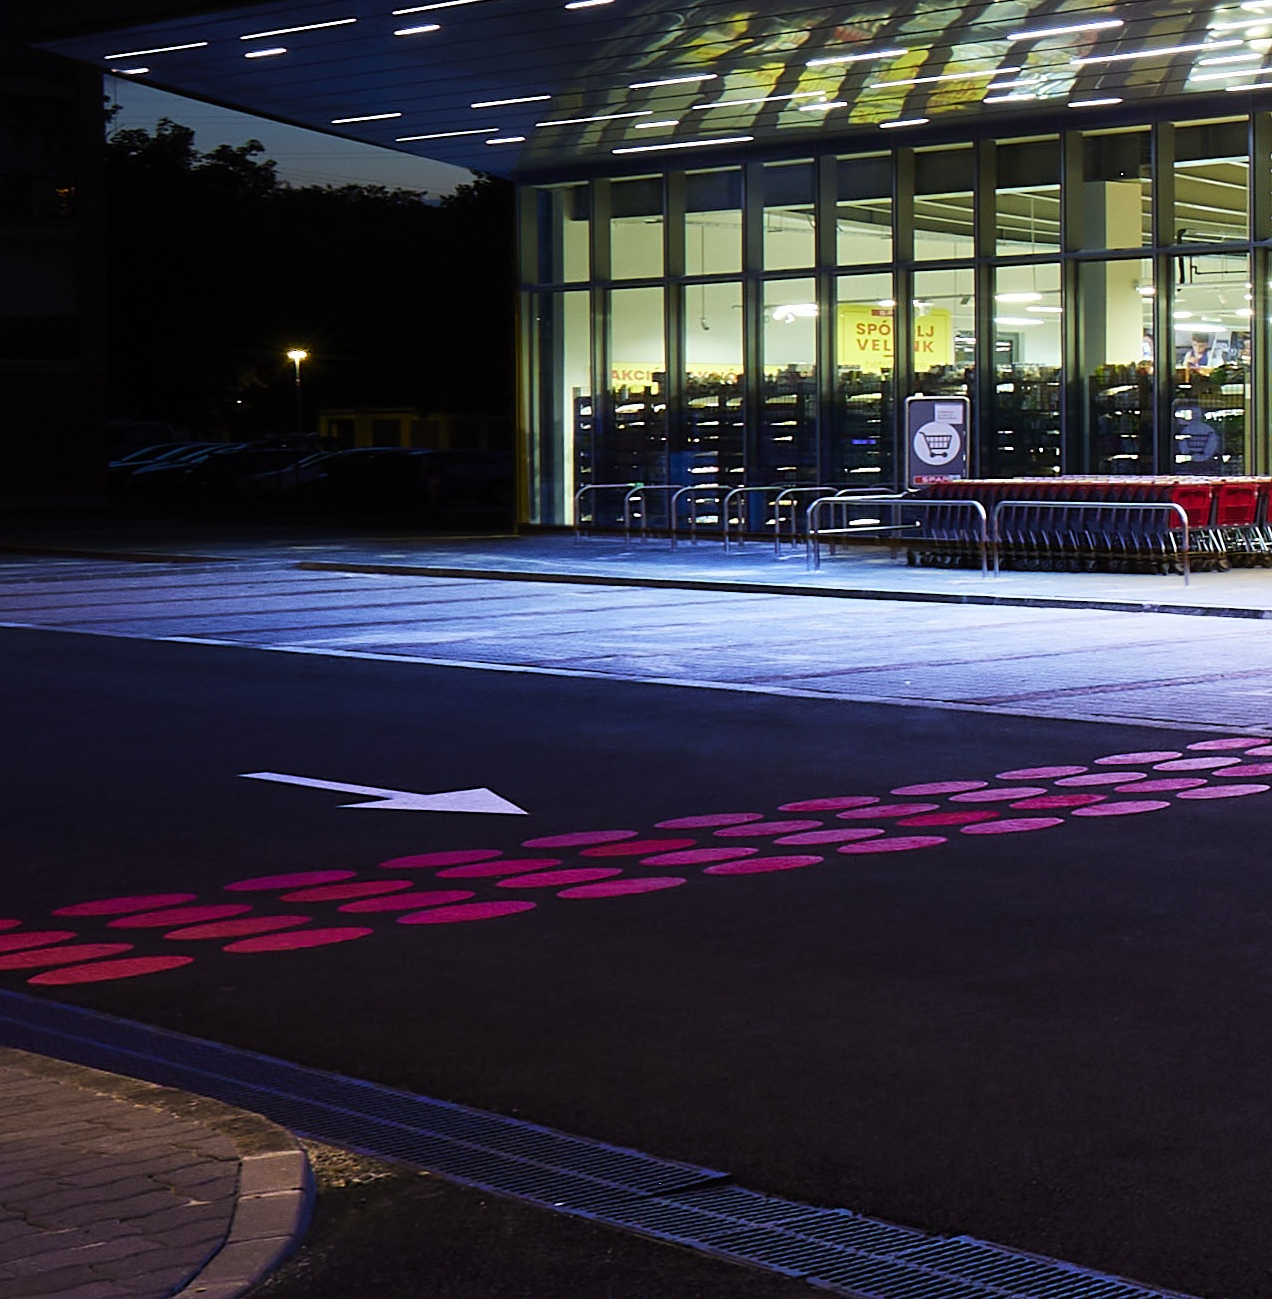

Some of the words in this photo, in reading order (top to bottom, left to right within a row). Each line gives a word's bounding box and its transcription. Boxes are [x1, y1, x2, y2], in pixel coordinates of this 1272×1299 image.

[856, 319, 935, 338] SPÓLJ
[856, 339, 935, 354] VELK
[611, 369, 651, 381] AKCI
